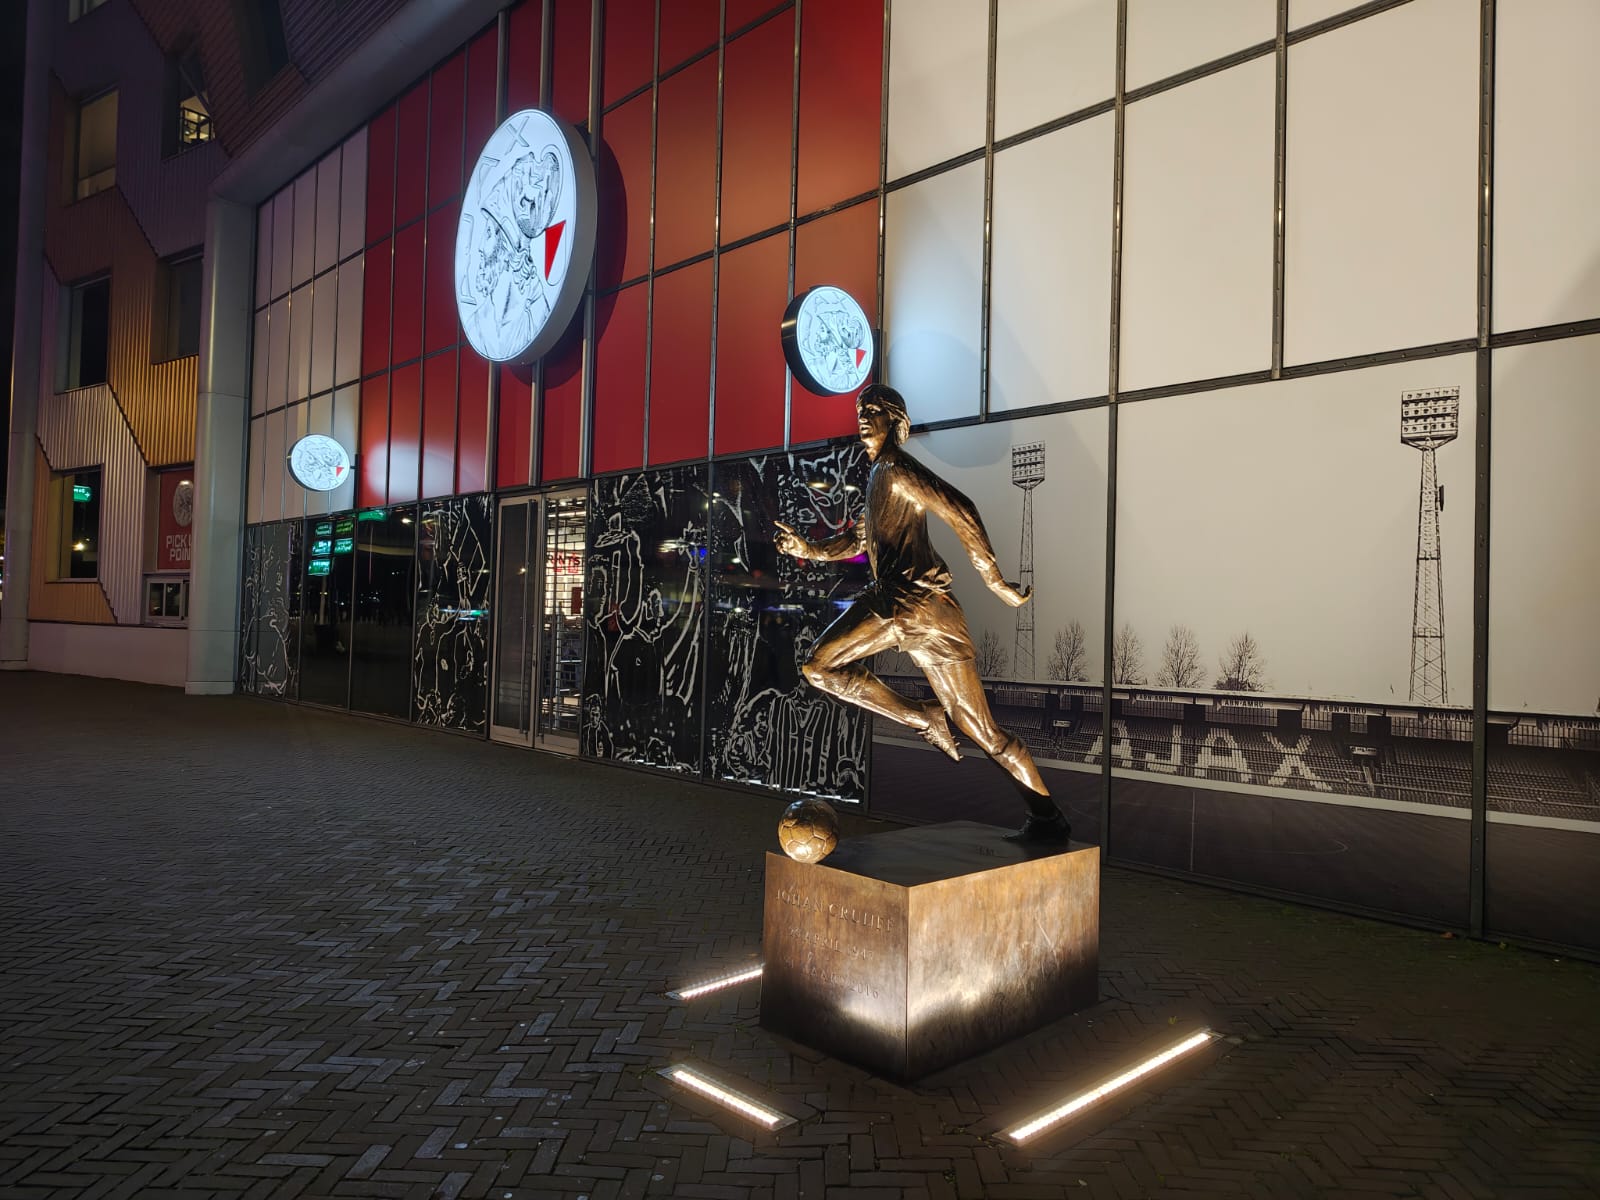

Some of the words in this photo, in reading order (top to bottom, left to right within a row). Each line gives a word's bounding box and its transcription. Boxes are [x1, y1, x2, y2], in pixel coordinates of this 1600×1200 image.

[166, 534, 187, 549] PICK
[170, 548, 191, 562] POIN
[1084, 719, 1333, 791] AJAX
[776, 889, 824, 914] JOHAN
